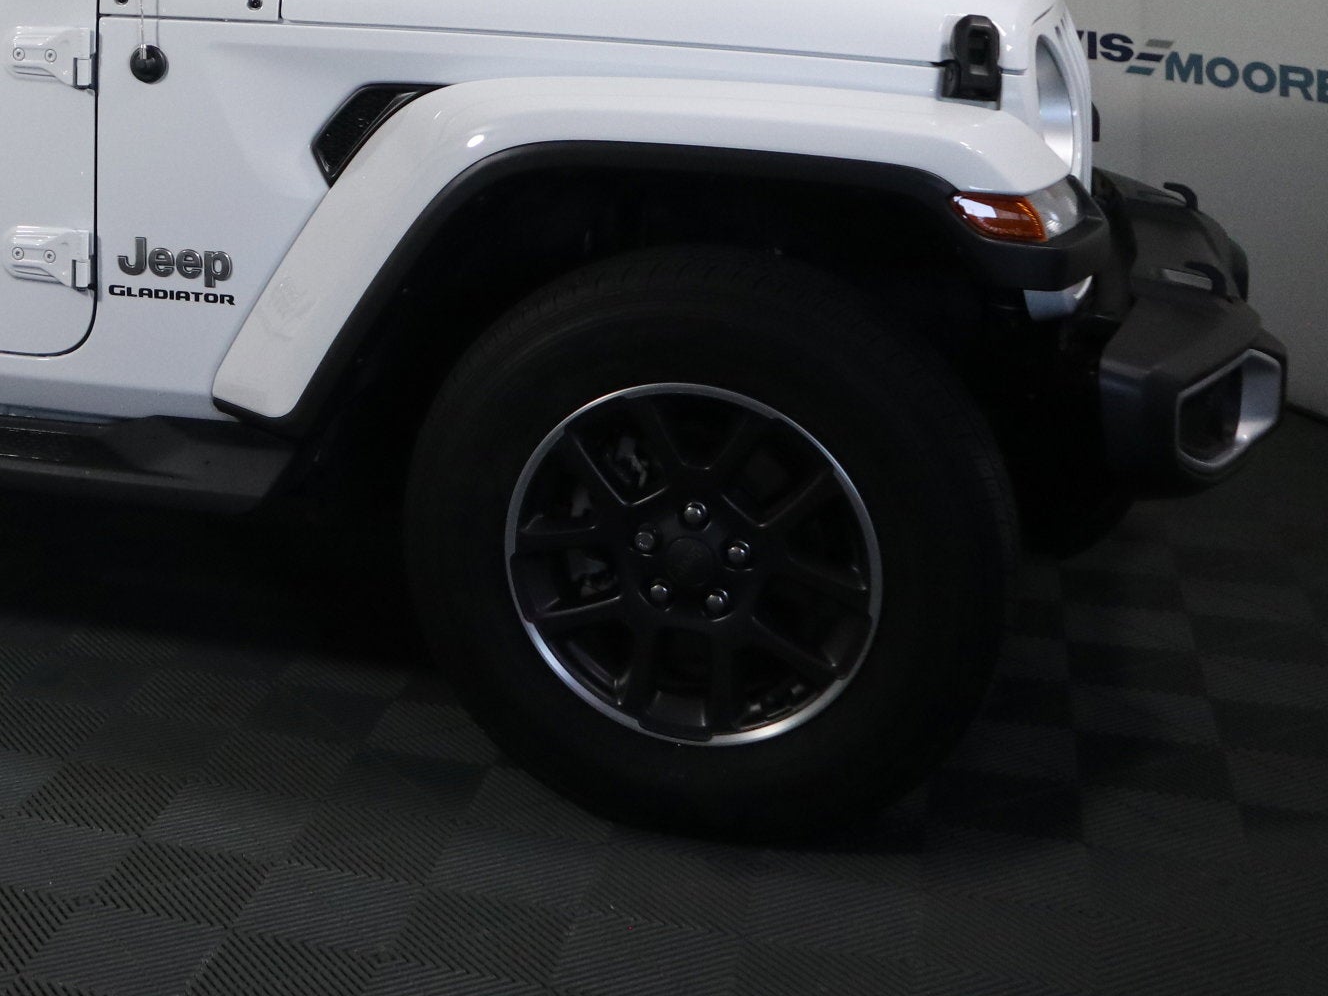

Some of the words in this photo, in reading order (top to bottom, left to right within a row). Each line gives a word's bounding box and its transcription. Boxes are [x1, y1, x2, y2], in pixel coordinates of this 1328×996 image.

[1076, 30, 1135, 63] IS
[117, 236, 233, 288] Jeep
[108, 284, 236, 306] GLADIATOR
